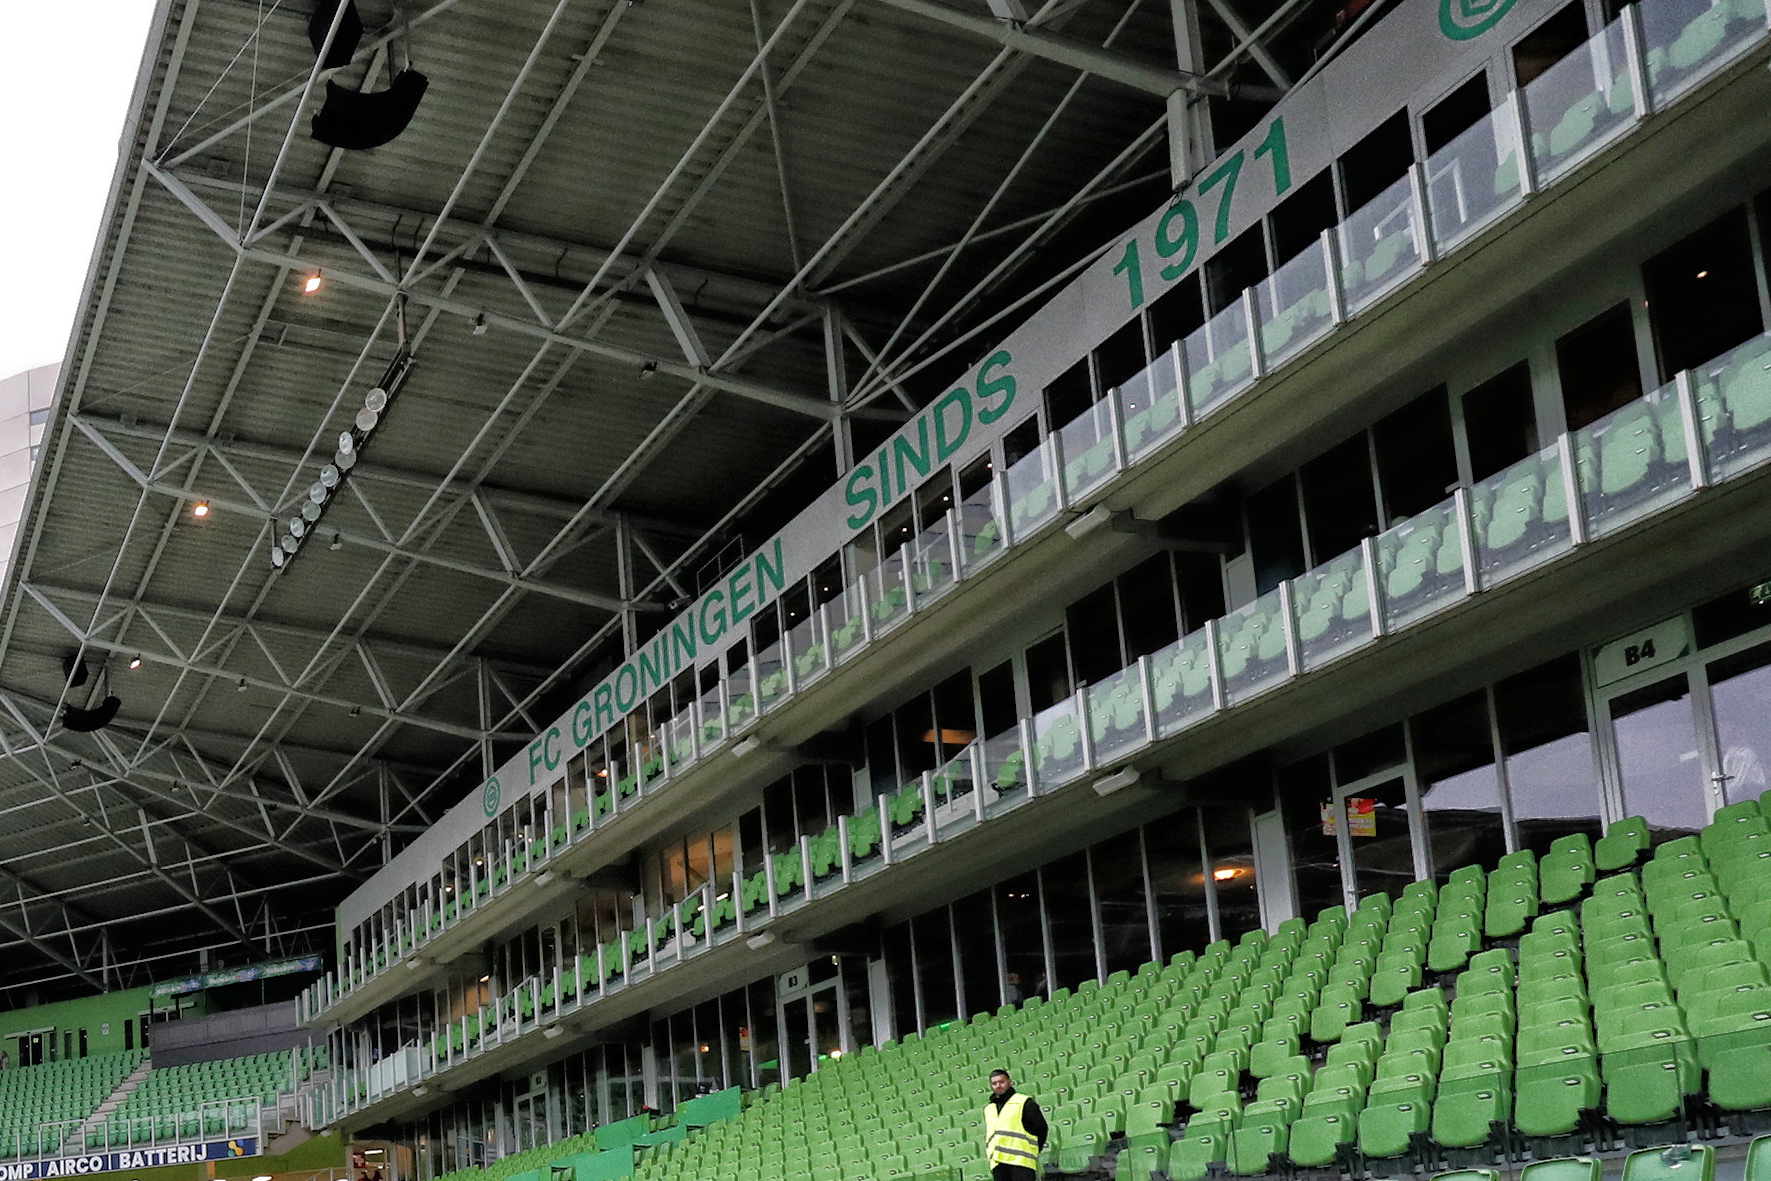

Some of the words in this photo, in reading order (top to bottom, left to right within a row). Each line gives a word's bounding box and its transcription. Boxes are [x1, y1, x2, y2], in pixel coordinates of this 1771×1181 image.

[529, 727, 562, 785] FC
[572, 537, 786, 755] GRONINGEN
[845, 350, 1017, 531] SINDS
[1113, 115, 1292, 310] 1971
[1624, 638, 1656, 667] B4
[47, 1157, 103, 1177] AIRCO
[119, 1145, 207, 1169] BATTERIJ
